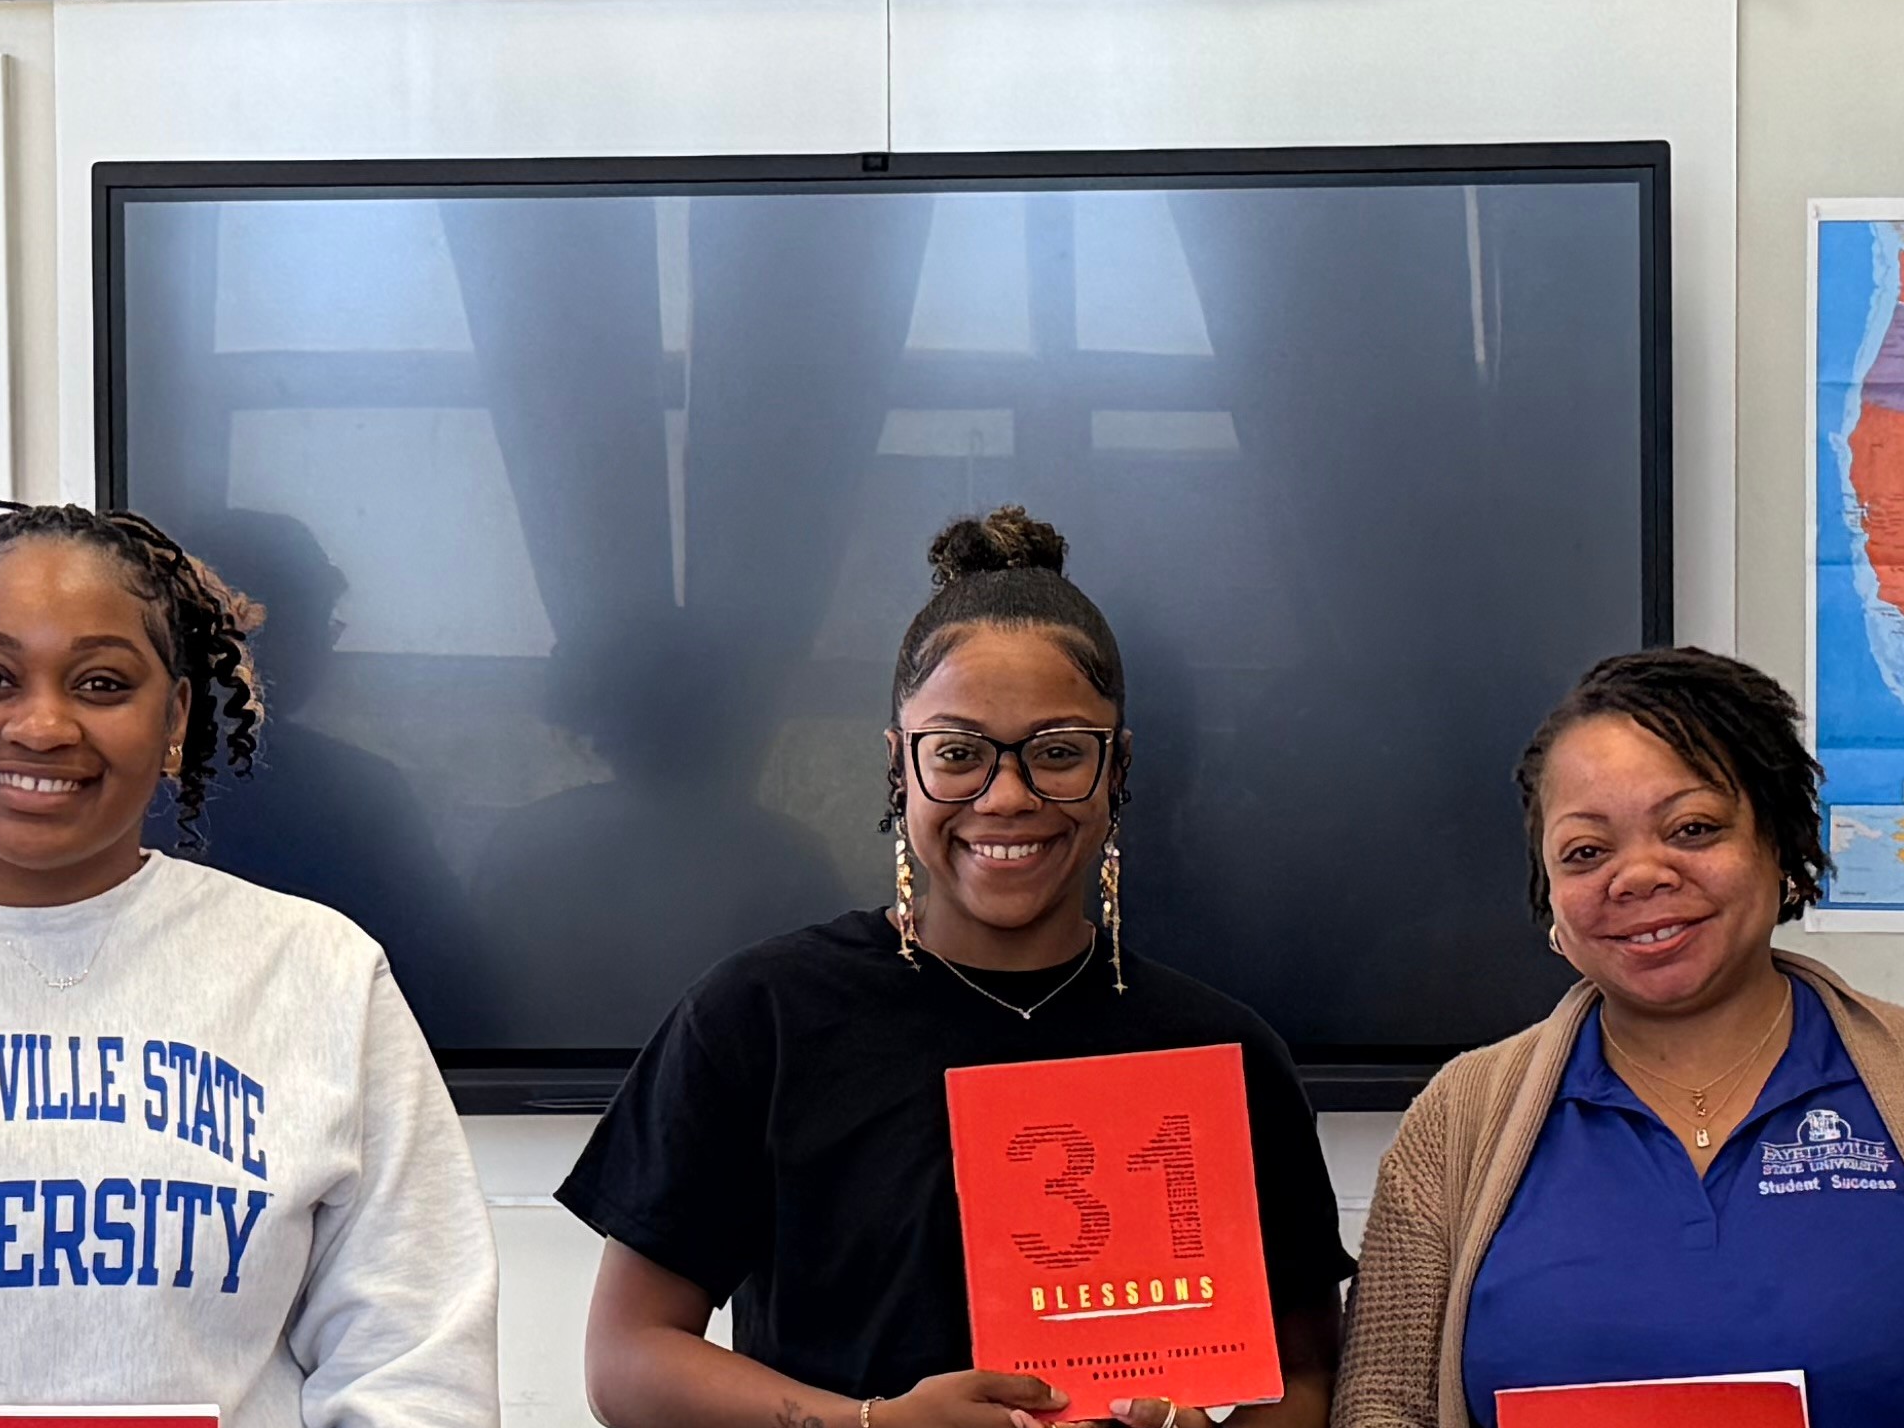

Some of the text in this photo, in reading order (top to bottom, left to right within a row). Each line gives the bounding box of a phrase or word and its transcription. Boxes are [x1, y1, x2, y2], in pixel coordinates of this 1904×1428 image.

[143, 1039, 268, 1181] STATE
[1762, 1143, 1886, 1161] FAYETTEVILLE
[1762, 1161, 1889, 1175] STATE UNIVERSITY
[1007, 1114, 1205, 1270] 31
[1758, 1175, 1897, 1195] Student Success
[1031, 1275, 1215, 1312] BLESSONS
